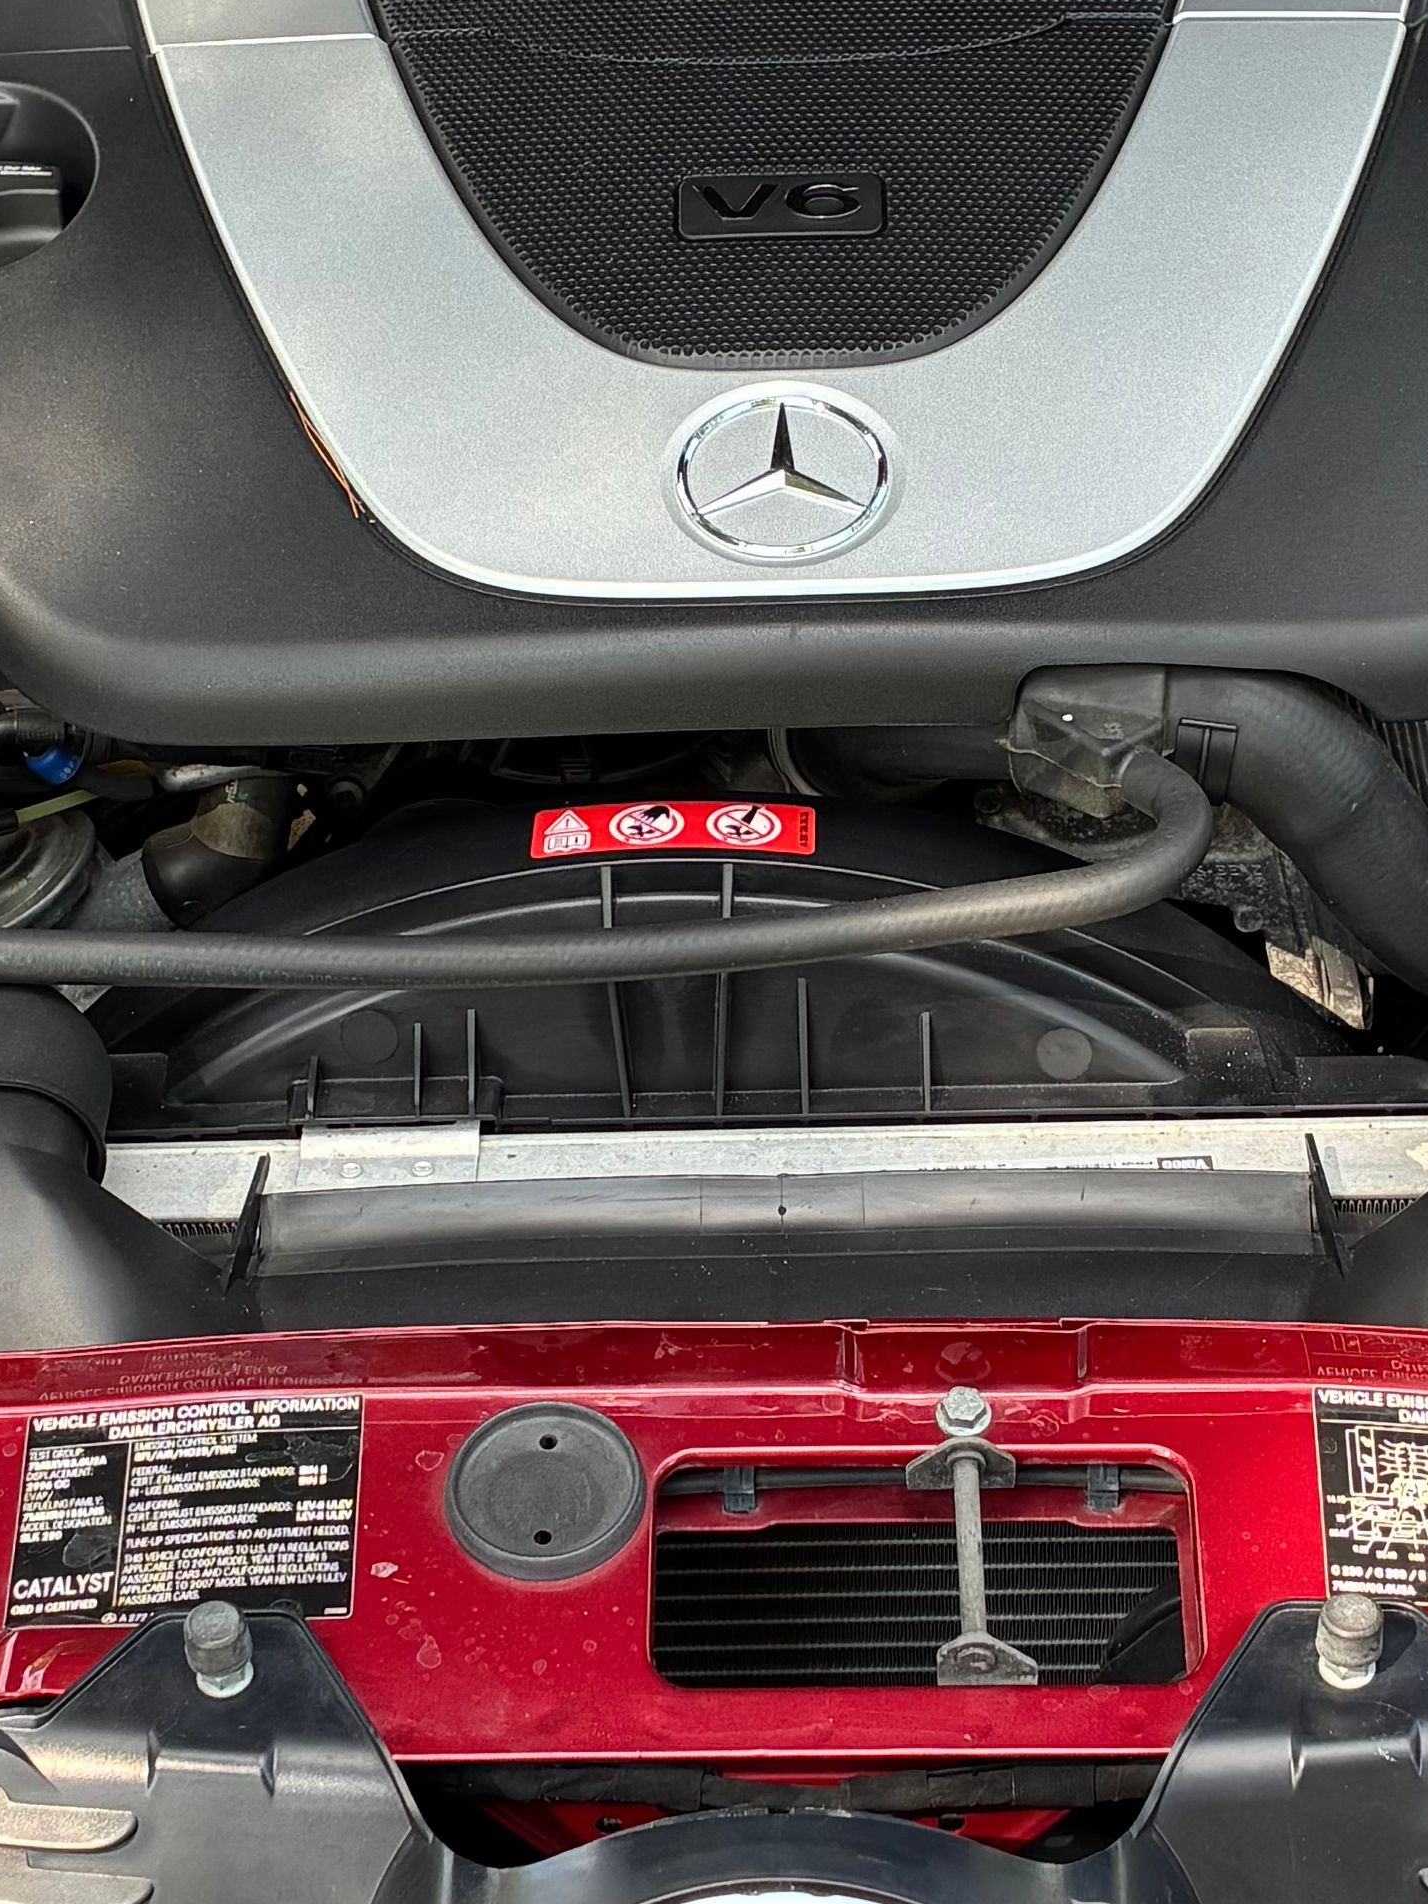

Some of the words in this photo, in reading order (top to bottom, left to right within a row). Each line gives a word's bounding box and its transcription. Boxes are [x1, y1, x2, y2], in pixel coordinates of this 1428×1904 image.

[693, 183, 861, 221] V6
[1318, 1389, 1384, 1407] VEHICLE
[33, 1413, 97, 1432] VEHICLE
[98, 1407, 174, 1427] EMISSION
[177, 1399, 250, 1419] CONTROL
[253, 1398, 360, 1413] INFORMATION
[108, 1416, 254, 1440] DAIMLERCHRYSLER
[257, 1414, 280, 1428] AG
[54, 1477, 70, 1490] CC
[13, 1571, 114, 1599] CATALYST
[44, 1598, 98, 1613] CERTIFIED
